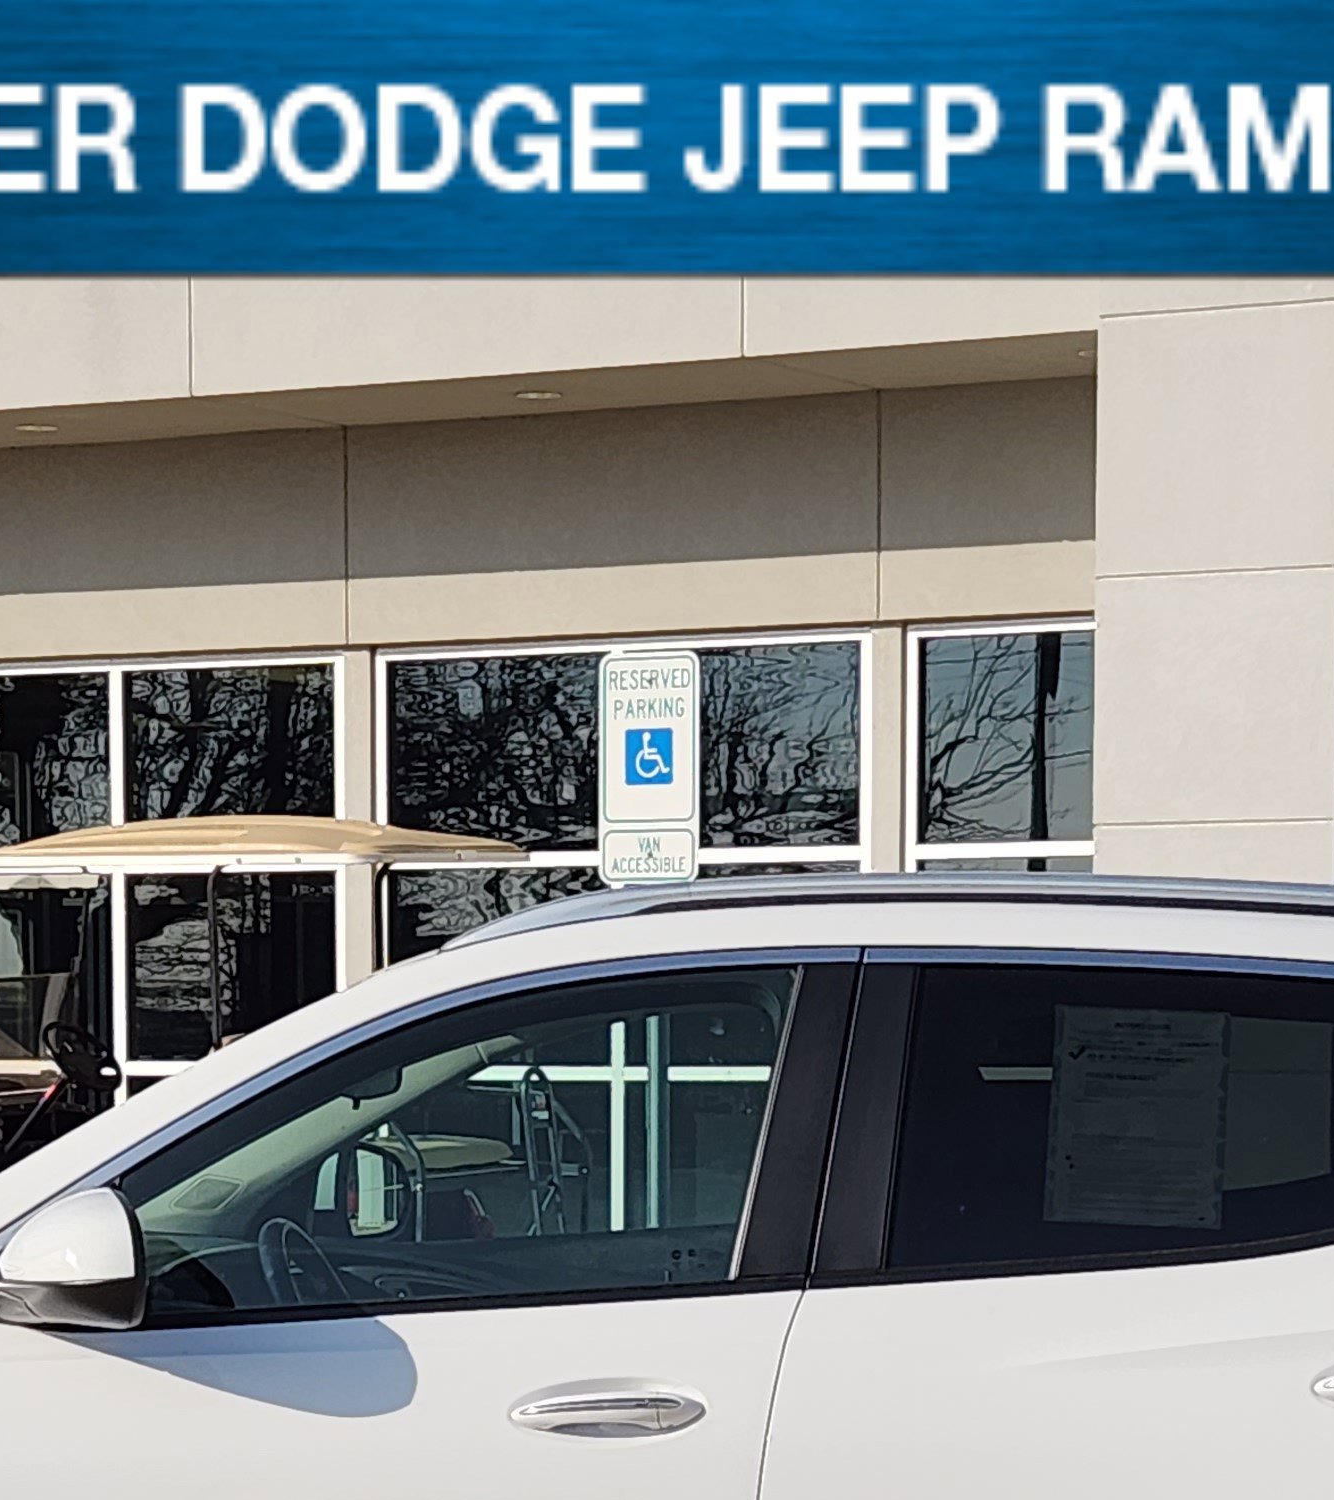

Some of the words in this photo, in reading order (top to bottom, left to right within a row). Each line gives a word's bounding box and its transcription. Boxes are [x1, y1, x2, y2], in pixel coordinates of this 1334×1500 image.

[608, 667, 691, 691] RESERVED
[613, 697, 685, 720] PARKING
[638, 836, 660, 853] VAN
[611, 856, 686, 874] ACCESSIBLE
